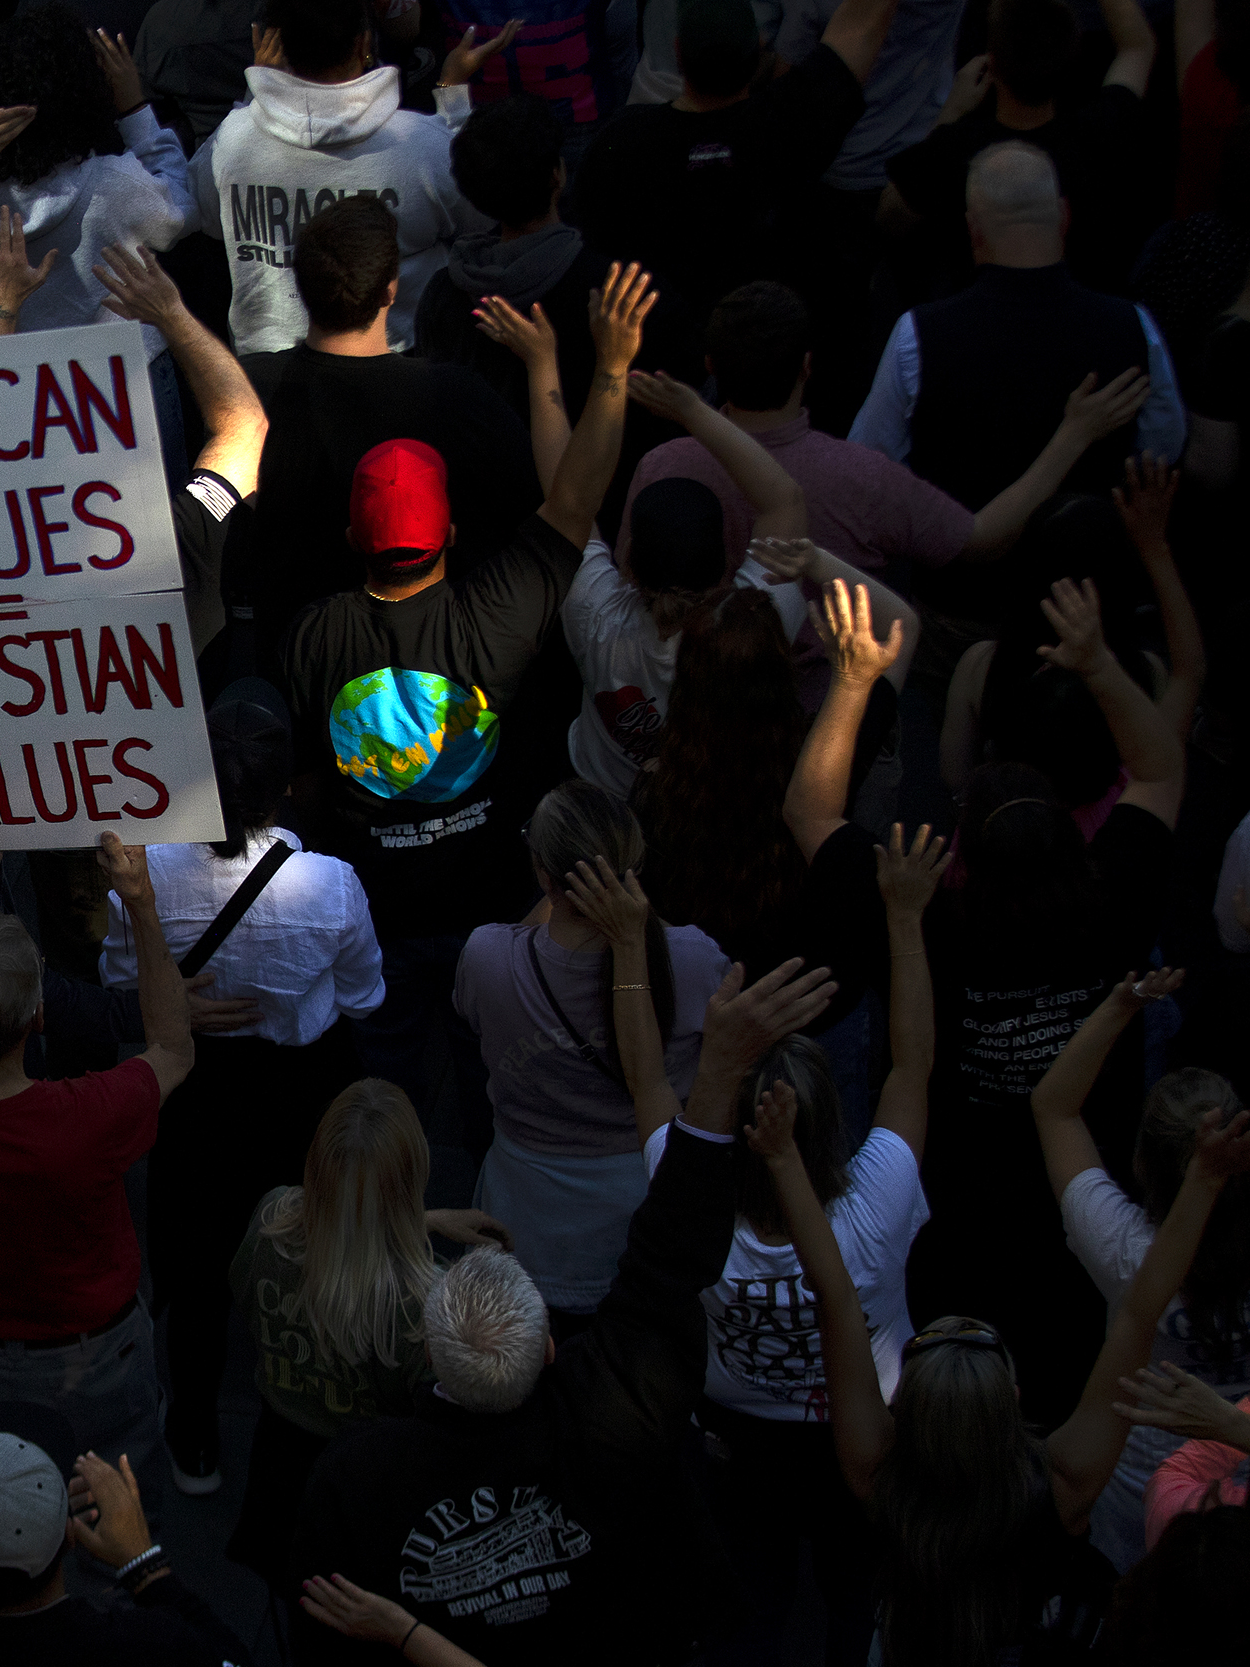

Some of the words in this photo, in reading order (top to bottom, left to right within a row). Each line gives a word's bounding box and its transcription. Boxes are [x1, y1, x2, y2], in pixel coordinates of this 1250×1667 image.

[230, 184, 399, 248] MIRA
[370, 823, 417, 837] UNTIL
[419, 818, 444, 833] THE
[380, 834, 434, 848] WORLD
[435, 812, 488, 840] KNOWS
[1023, 1007, 1071, 1027] JESUS
[976, 1036, 1010, 1048] AND
[1012, 1035, 1027, 1048] IN
[1028, 1022, 1072, 1044] DOING
[1012, 1040, 1067, 1061] PEOPLE
[959, 1062, 996, 1080] WITH
[998, 1073, 1028, 1084] THE
[446, 1589, 502, 1618] REVIVAL
[502, 1581, 520, 1600] IN
[519, 1574, 546, 1596] OUR
[546, 1569, 572, 1591] DAY
